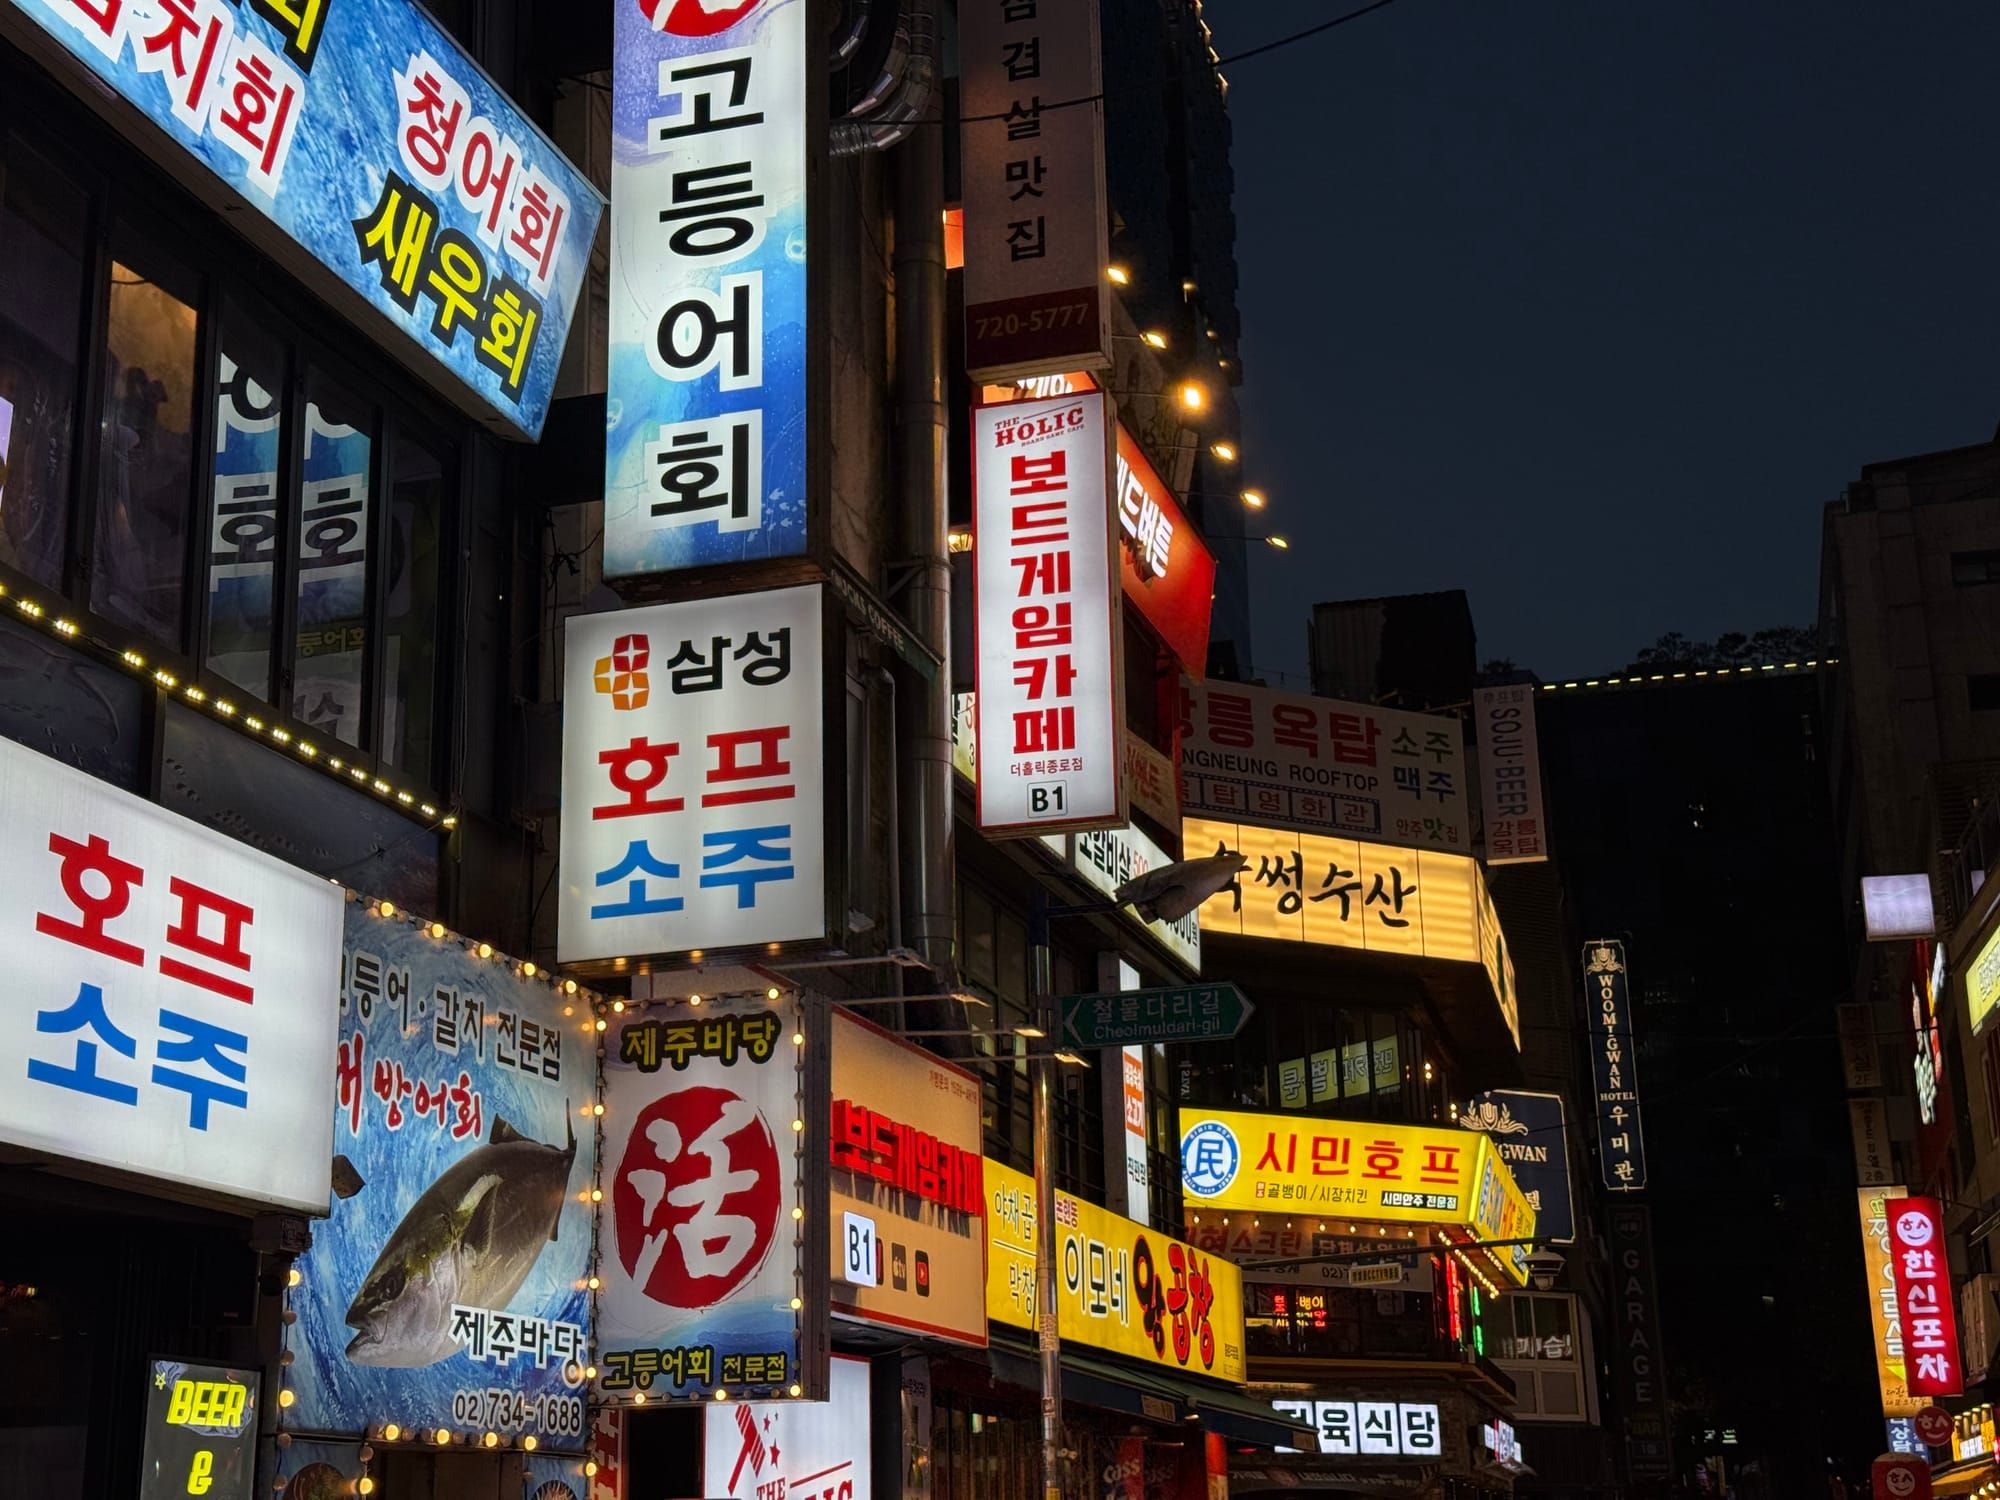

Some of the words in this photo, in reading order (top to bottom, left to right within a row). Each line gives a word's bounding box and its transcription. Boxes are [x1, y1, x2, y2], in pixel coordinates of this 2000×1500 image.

[406, 70, 564, 283] 청어회
[365, 190, 536, 388] 새우회
[651, 57, 764, 519] 고등어회
[975, 303, 1089, 341] 720-5777
[994, 416, 1020, 431] THE
[995, 407, 1084, 448] HOLIC
[1010, 450, 1077, 754] 보드게임카페
[667, 627, 791, 695] 삼성
[1010, 757, 1084, 776] 더홀릭종로점
[1391, 726, 1453, 763] 소주
[592, 725, 796, 820] 호프
[1290, 763, 1379, 792] ROOFTOP
[1393, 766, 1456, 803] 맥주
[1031, 785, 1064, 813] B1
[591, 824, 795, 920] 소주
[36, 832, 254, 1004] 호프
[1093, 990, 1220, 1023] 철물다리길
[1093, 1016, 1220, 1040] Cheolmuldari-gil
[1598, 974, 1622, 1089] WOOMIGWAN
[28, 981, 248, 1131] 소주
[497, 1011, 561, 1082] 전문점
[626, 1016, 776, 1067] 제주바당
[1600, 1091, 1635, 1101] HOTEL
[1191, 1138, 1224, 1180] 民
[1256, 1132, 1460, 1184] 시민호프
[1495, 1140, 1548, 1163] GWAN
[1609, 1105, 1635, 1182] 우미관
[626, 1098, 761, 1290] 活
[995, 1184, 1037, 1240] 야채곱
[1382, 1191, 1424, 1206] 시민안주
[1426, 1195, 1458, 1210] 전문점
[849, 1223, 871, 1277] B1
[1009, 1262, 1035, 1315] 막창
[1065, 1234, 1129, 1326] 이모네
[1622, 1248, 1652, 1403] GARAGE
[1902, 1250, 1950, 1383] 한신포차
[452, 1308, 584, 1385] 제주바당
[604, 1348, 712, 1389] 고등어회
[723, 1354, 786, 1384] 전문점
[166, 1380, 247, 1428] BEER
[453, 1390, 582, 1436] 02)734-1688
[1283, 1406, 1436, 1450] 육식당
[757, 1477, 786, 1500] THE
